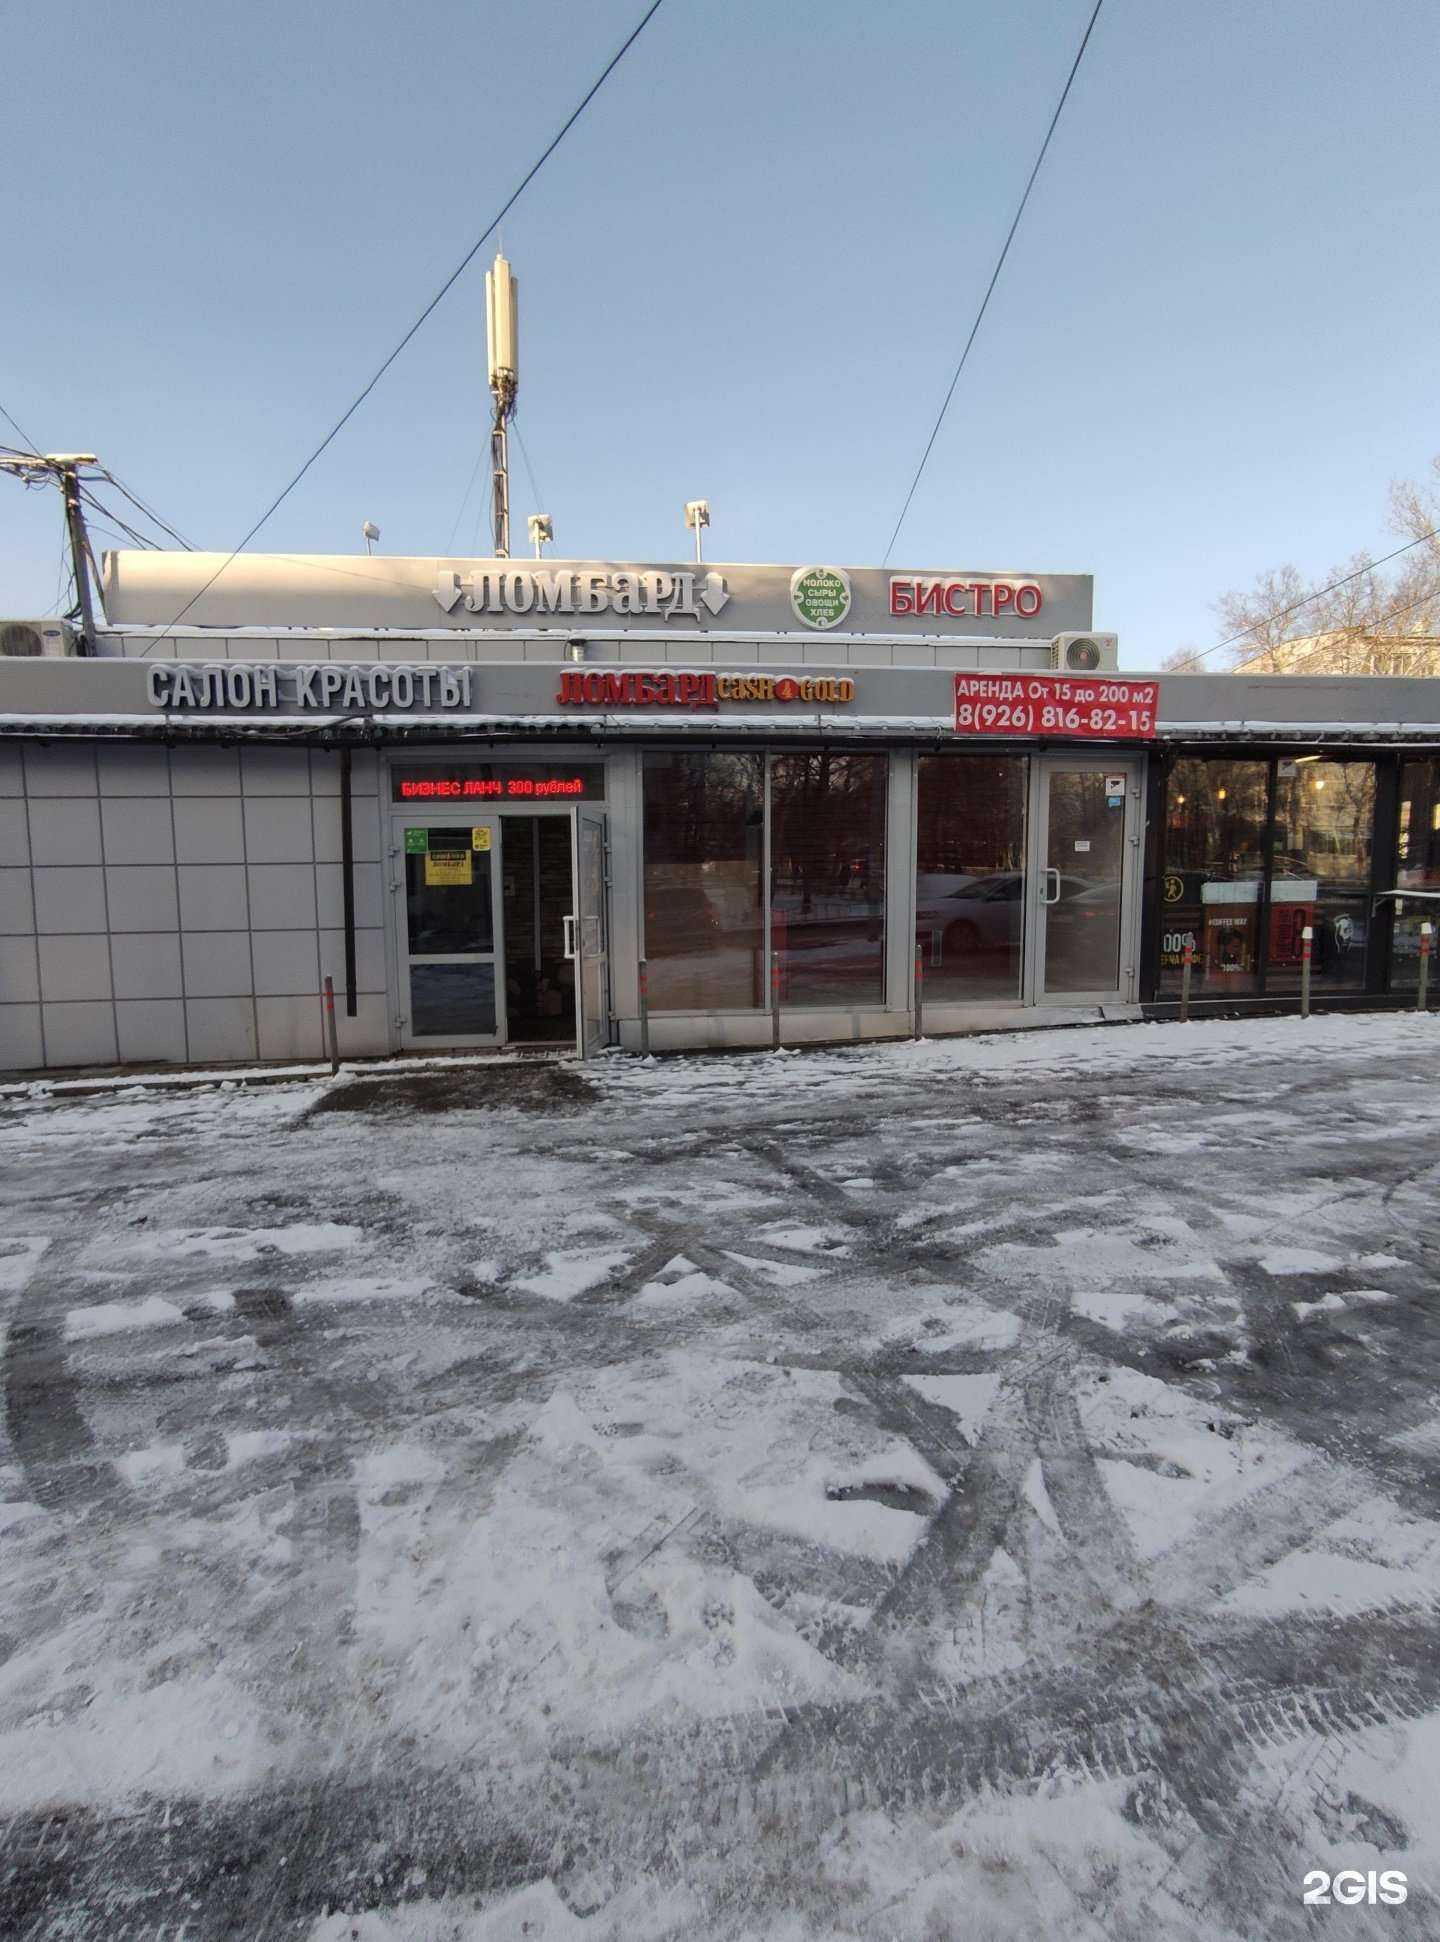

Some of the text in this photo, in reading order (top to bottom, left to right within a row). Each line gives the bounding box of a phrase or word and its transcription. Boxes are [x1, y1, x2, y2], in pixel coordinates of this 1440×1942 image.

[803, 579, 841, 588] МОЛОКО
[807, 589, 837, 597] СЫРЫ
[805, 598, 840, 607] ОВОЩИ
[889, 579, 1043, 618] БИСТРО
[810, 608, 835, 617] ХЛЕБ
[147, 665, 472, 708] САЛОН КРАСОТЫ
[957, 680, 1025, 701] АРЕНДА
[1054, 683, 1071, 700] 15
[1075, 688, 1095, 703] до
[1099, 686, 1129, 703] 200
[1132, 688, 1154, 704] м2
[958, 703, 1151, 732] 8(926) 816-82-15
[401, 777, 583, 797] БИЗНЕС ЛАНЧ 300 рублей
